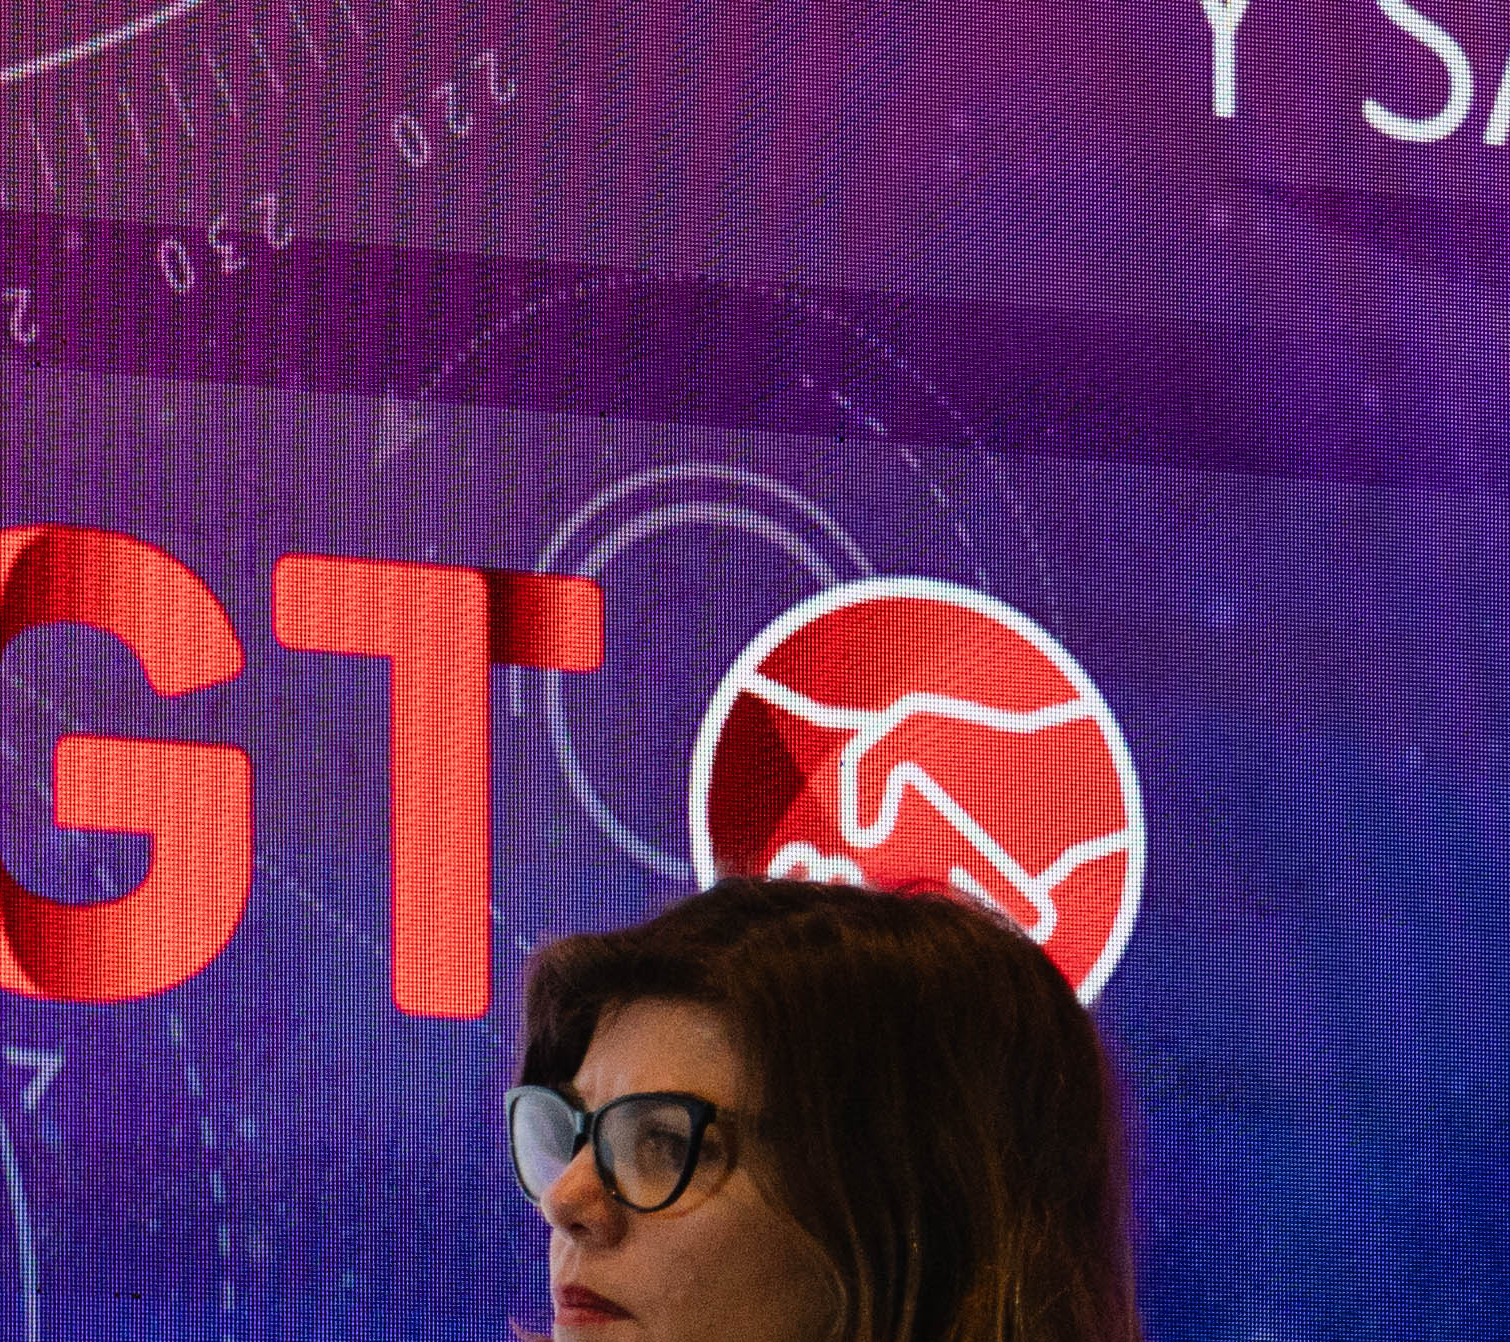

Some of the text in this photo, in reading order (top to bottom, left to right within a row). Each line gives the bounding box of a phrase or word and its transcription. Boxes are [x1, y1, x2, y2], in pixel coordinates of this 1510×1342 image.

[388, 46, 519, 170] 220
[1200, 0, 1510, 145] Y S
[157, 189, 298, 295] 230
